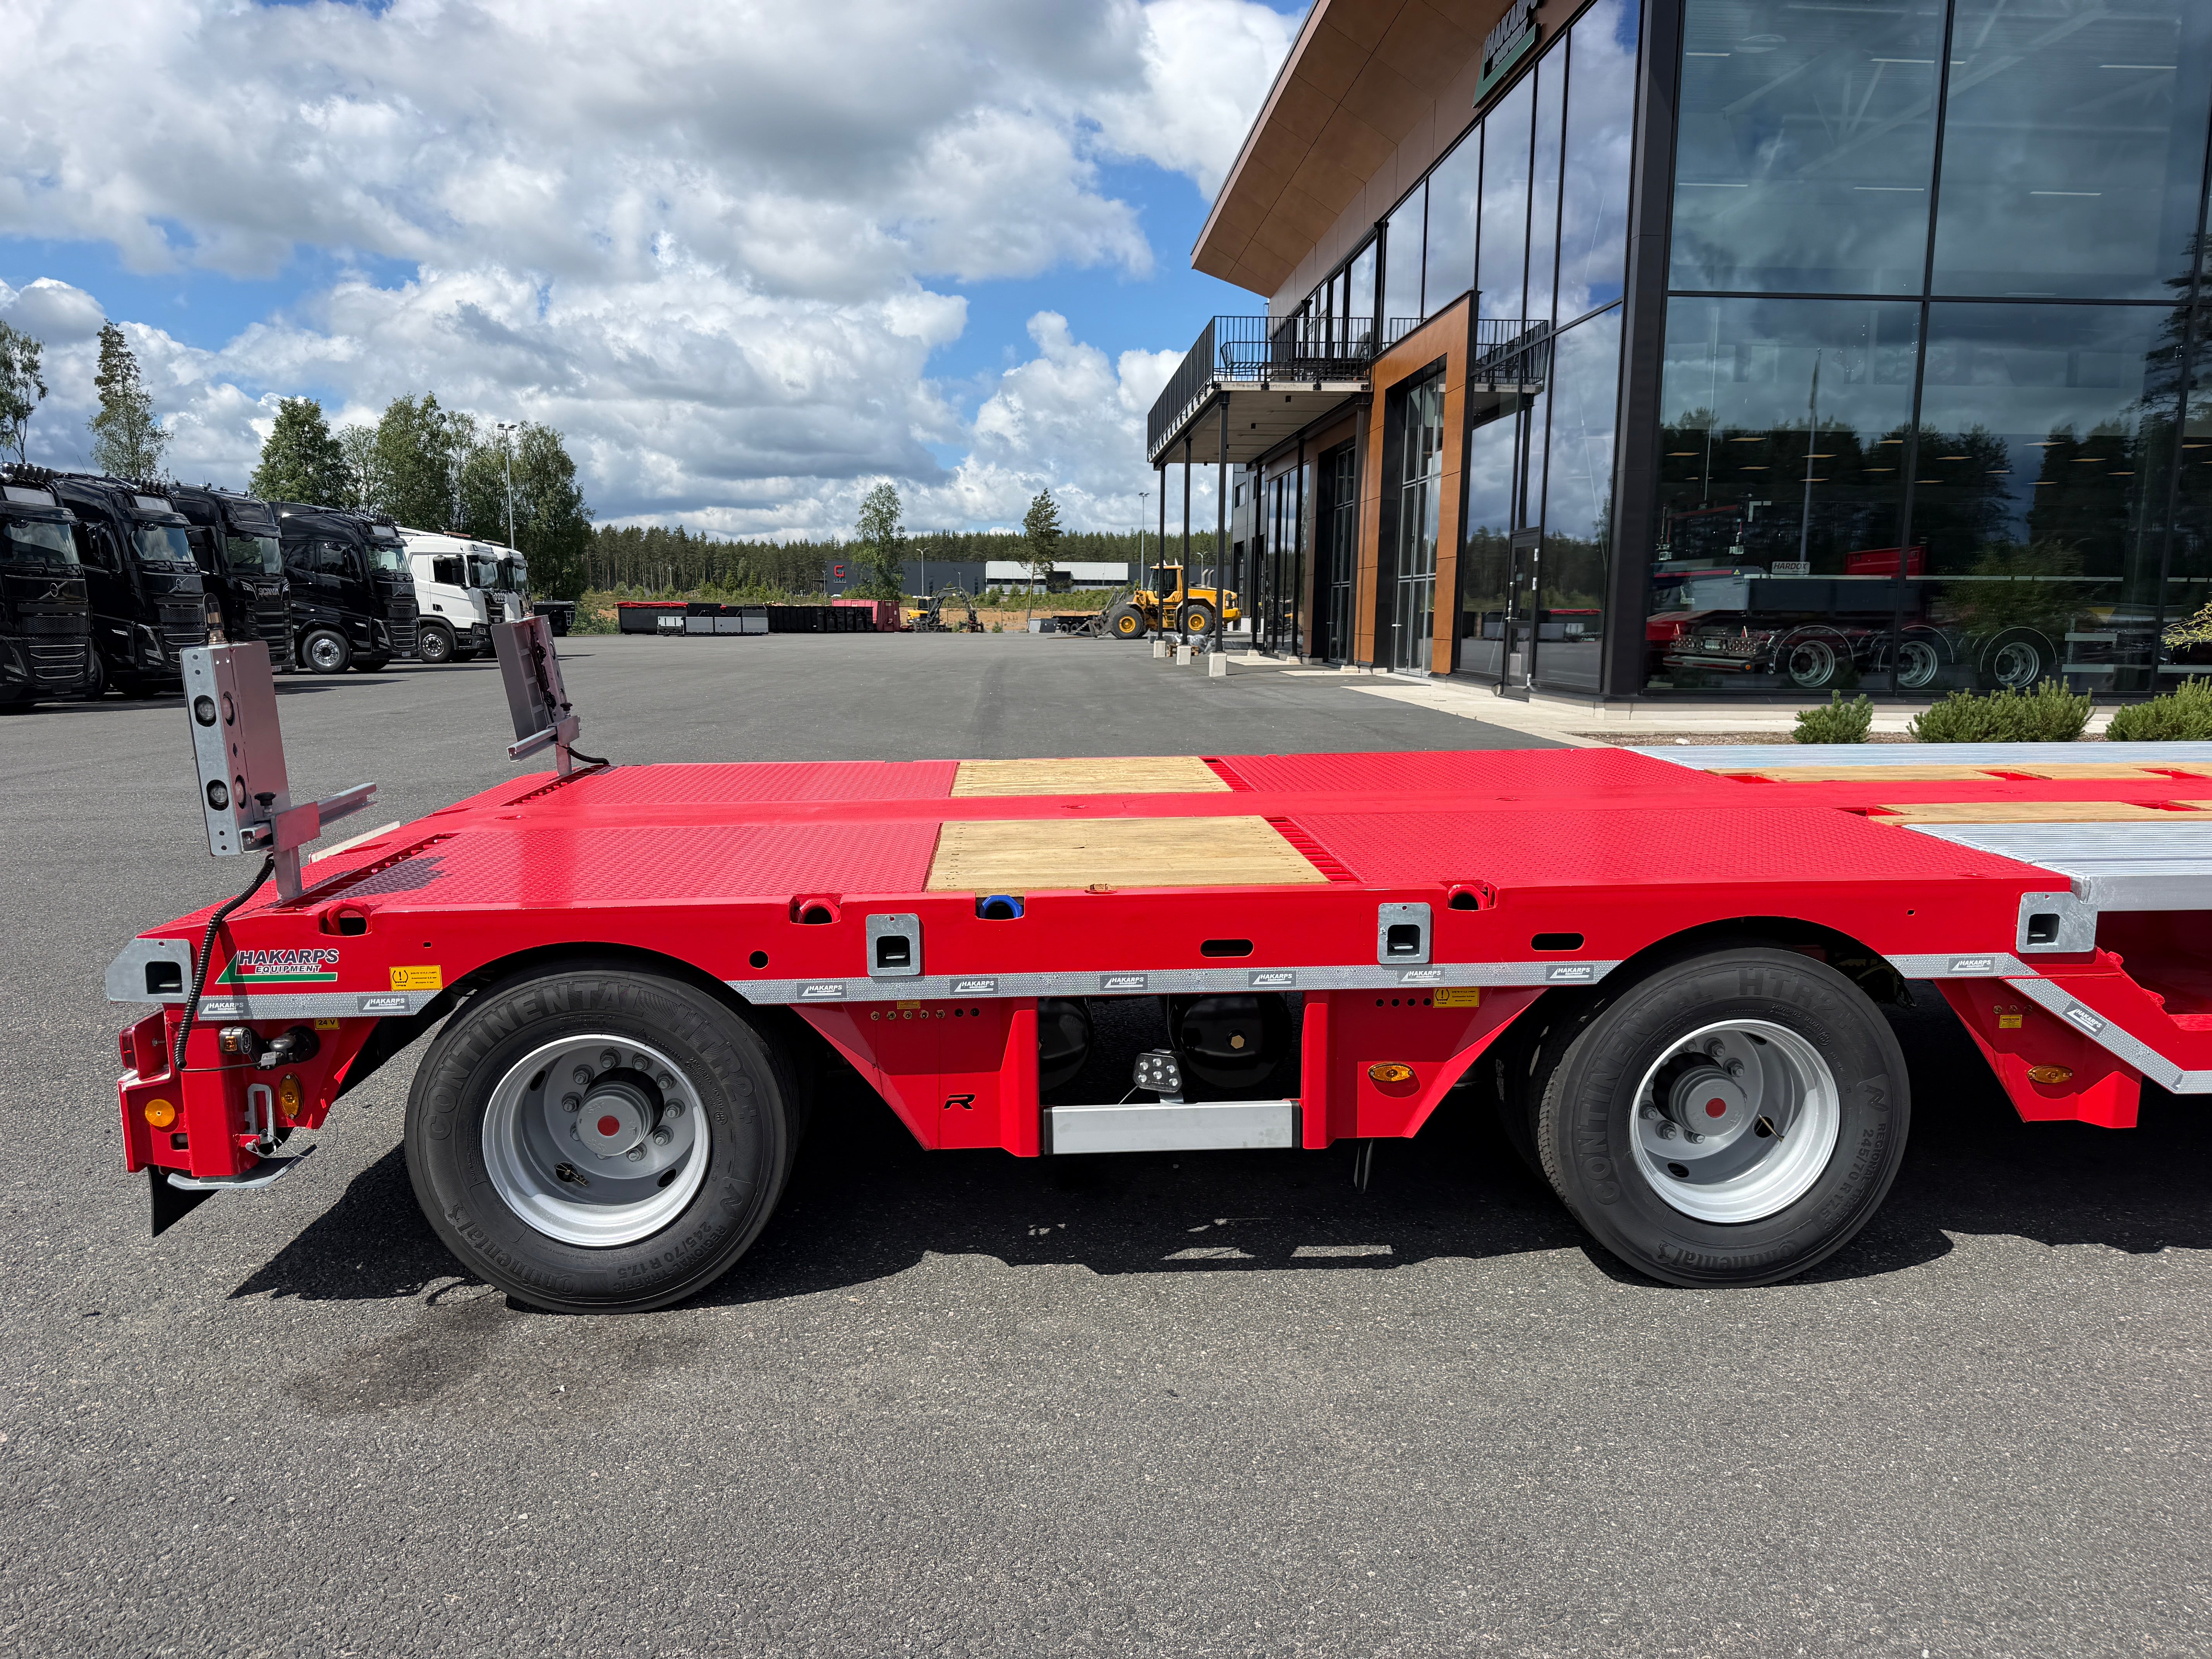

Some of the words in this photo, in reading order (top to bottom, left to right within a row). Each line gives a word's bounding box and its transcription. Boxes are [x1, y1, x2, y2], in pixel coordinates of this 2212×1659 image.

[1485, 0, 1537, 64] HAKARP
[239, 949, 339, 965] HAKARPS
[255, 964, 321, 974] EQUIPMENT
[2076, 1009, 2102, 1028] HAKARPS
[424, 981, 644, 1140] CONTINENTAL
[1824, 1123, 1887, 1231] REGIONAL-TRAFFIC
[1848, 1129, 1874, 1182] 245/70
[454, 1221, 581, 1294] Continental
[613, 1224, 727, 1293] REGIONAL-TRAFFIC
[617, 1259, 662, 1279] R17.5
[663, 1221, 713, 1264] 245/70
